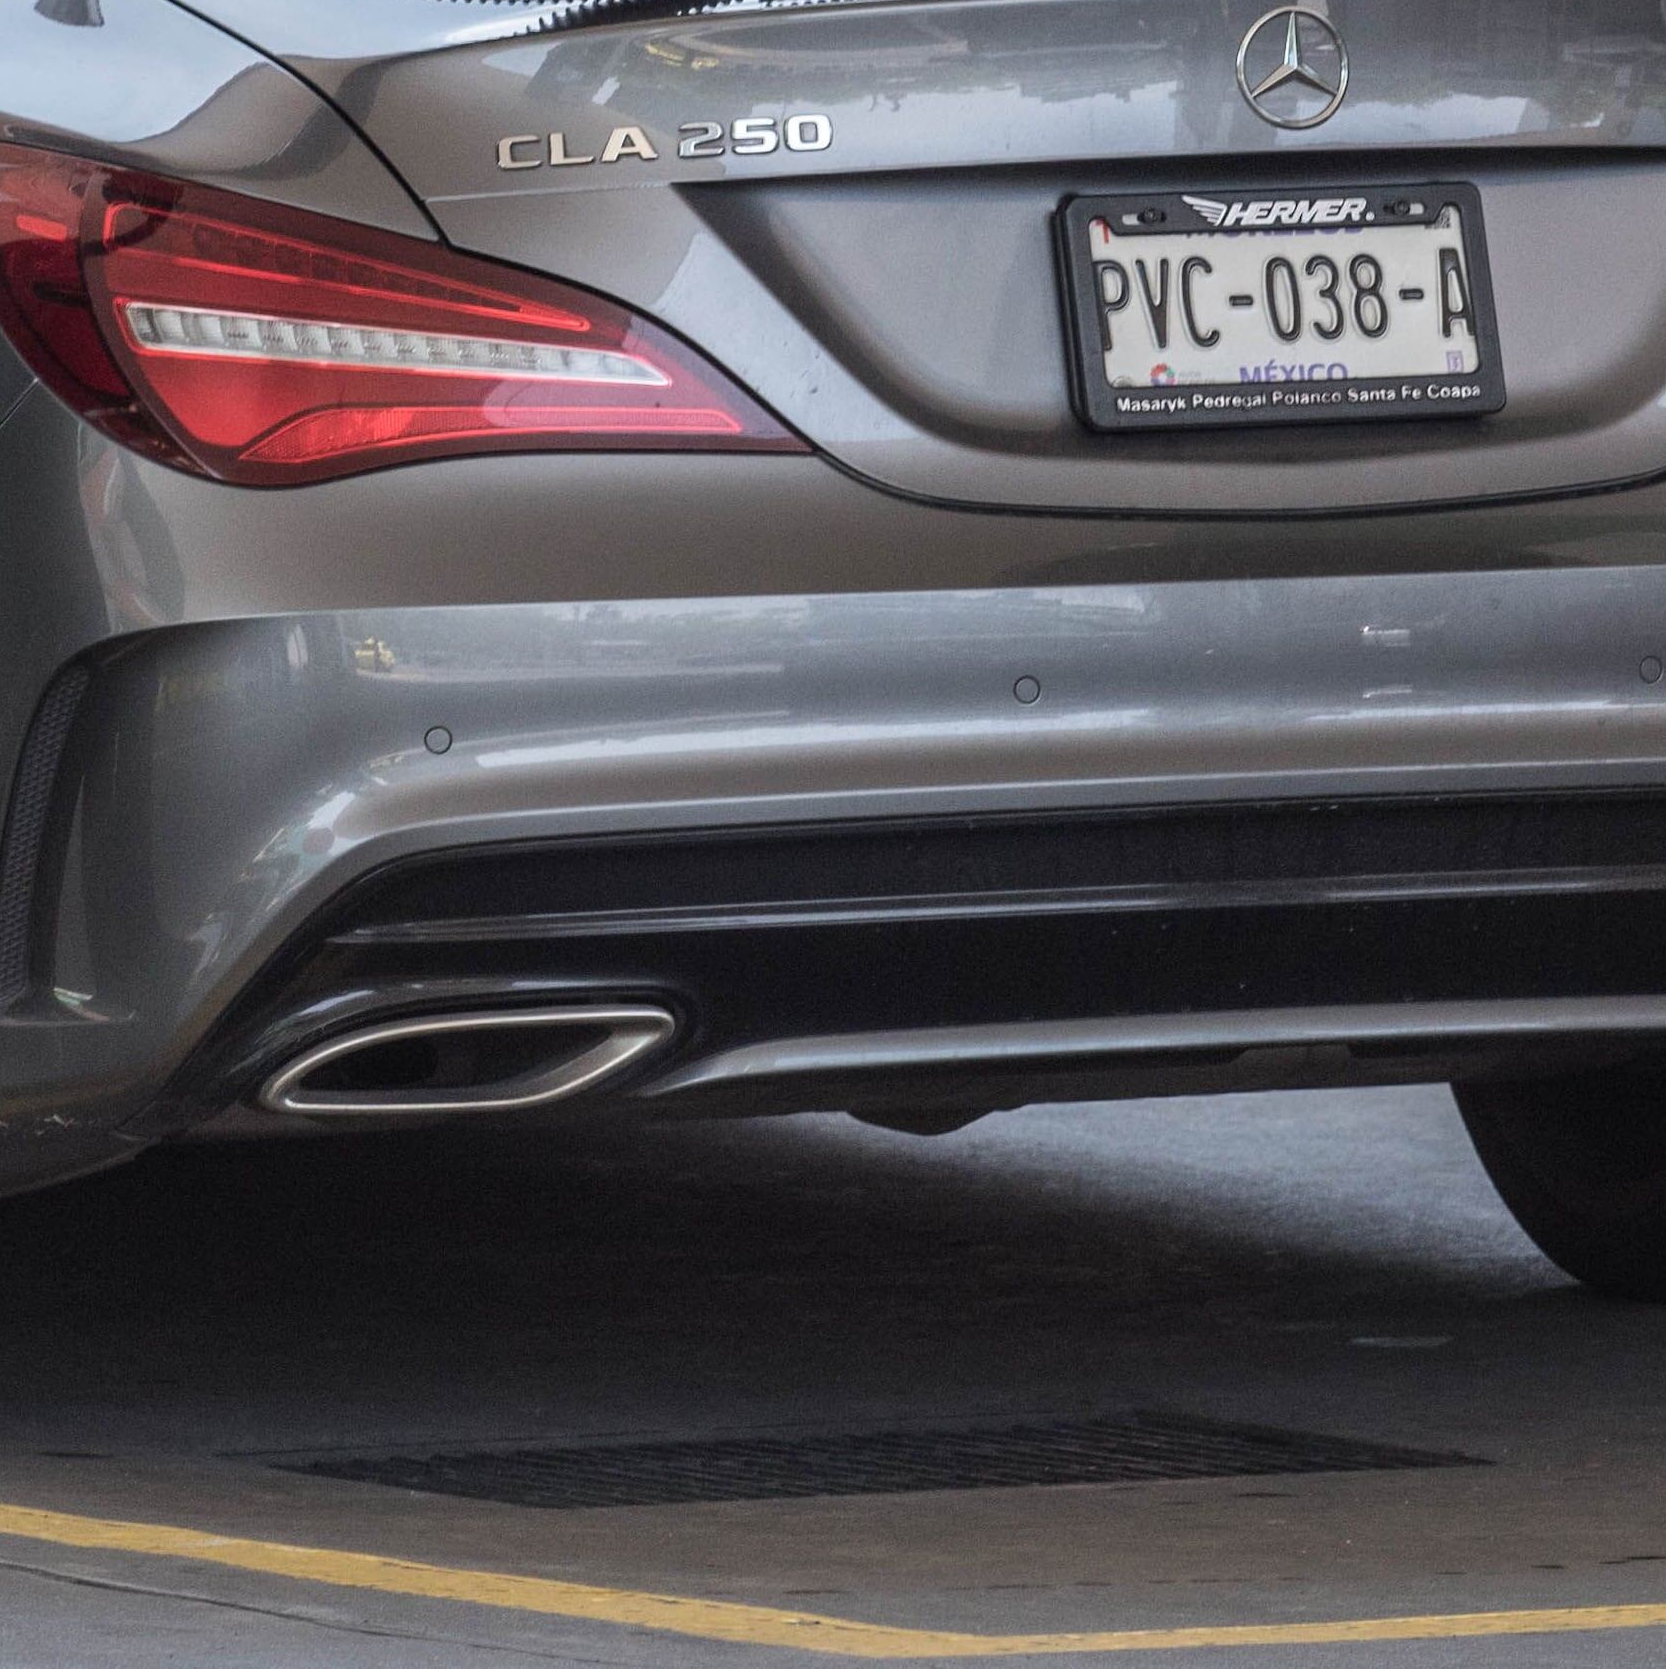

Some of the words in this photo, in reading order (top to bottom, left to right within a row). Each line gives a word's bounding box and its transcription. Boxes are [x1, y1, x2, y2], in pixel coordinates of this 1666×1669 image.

[496, 126, 659, 170] CLA
[677, 113, 833, 159] 250
[1093, 246, 1474, 352] PVC-038-A
[1117, 397, 1187, 414] Masaryk
[1192, 393, 1267, 411] Pedregal
[1272, 390, 1342, 406] Polanco
[1347, 387, 1397, 404] Santa
[1402, 385, 1422, 400] Fe
[1427, 384, 1482, 402] Coapa
